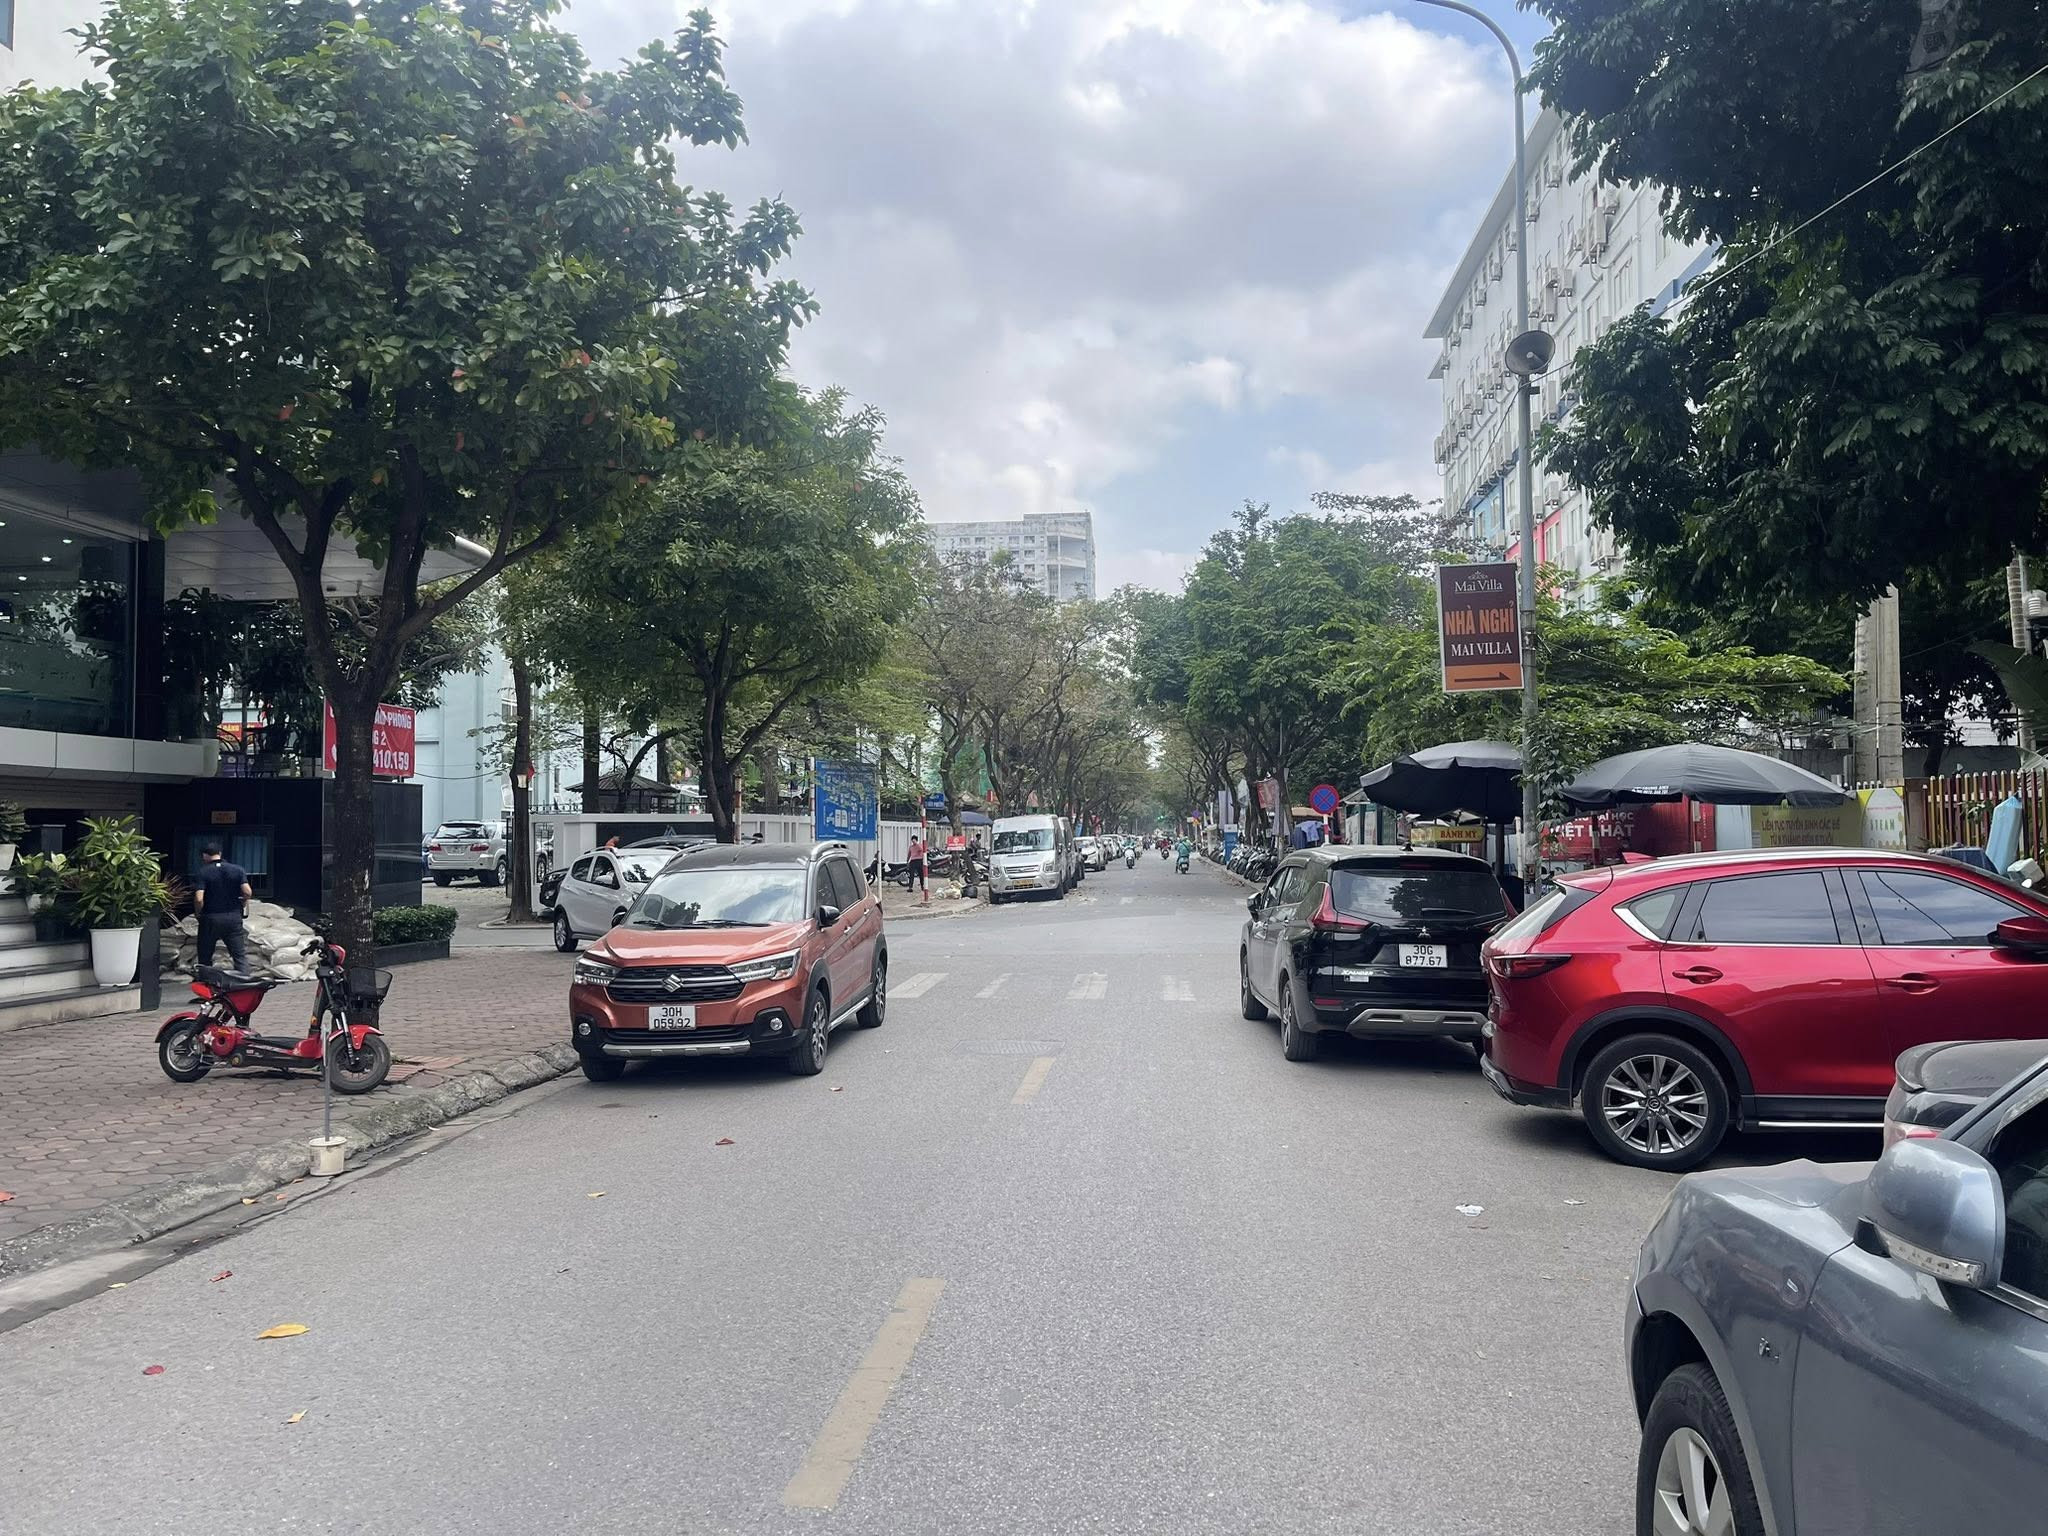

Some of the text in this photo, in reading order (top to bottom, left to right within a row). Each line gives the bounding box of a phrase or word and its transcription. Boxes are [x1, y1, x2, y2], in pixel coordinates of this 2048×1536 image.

[1455, 579, 1503, 592] Mai Villa
[1444, 600, 1515, 636] NHÀ NGHỈ
[1451, 641, 1512, 657] MAI VILLA
[387, 709, 412, 729] PHÒNG
[373, 748, 410, 771] 410.159
[1611, 812, 1634, 822] HỌC
[1870, 819, 1895, 831] STEAM
[1413, 945, 1434, 955] 30G
[1405, 955, 1442, 966] 877.67
[661, 1006, 683, 1017] 30H
